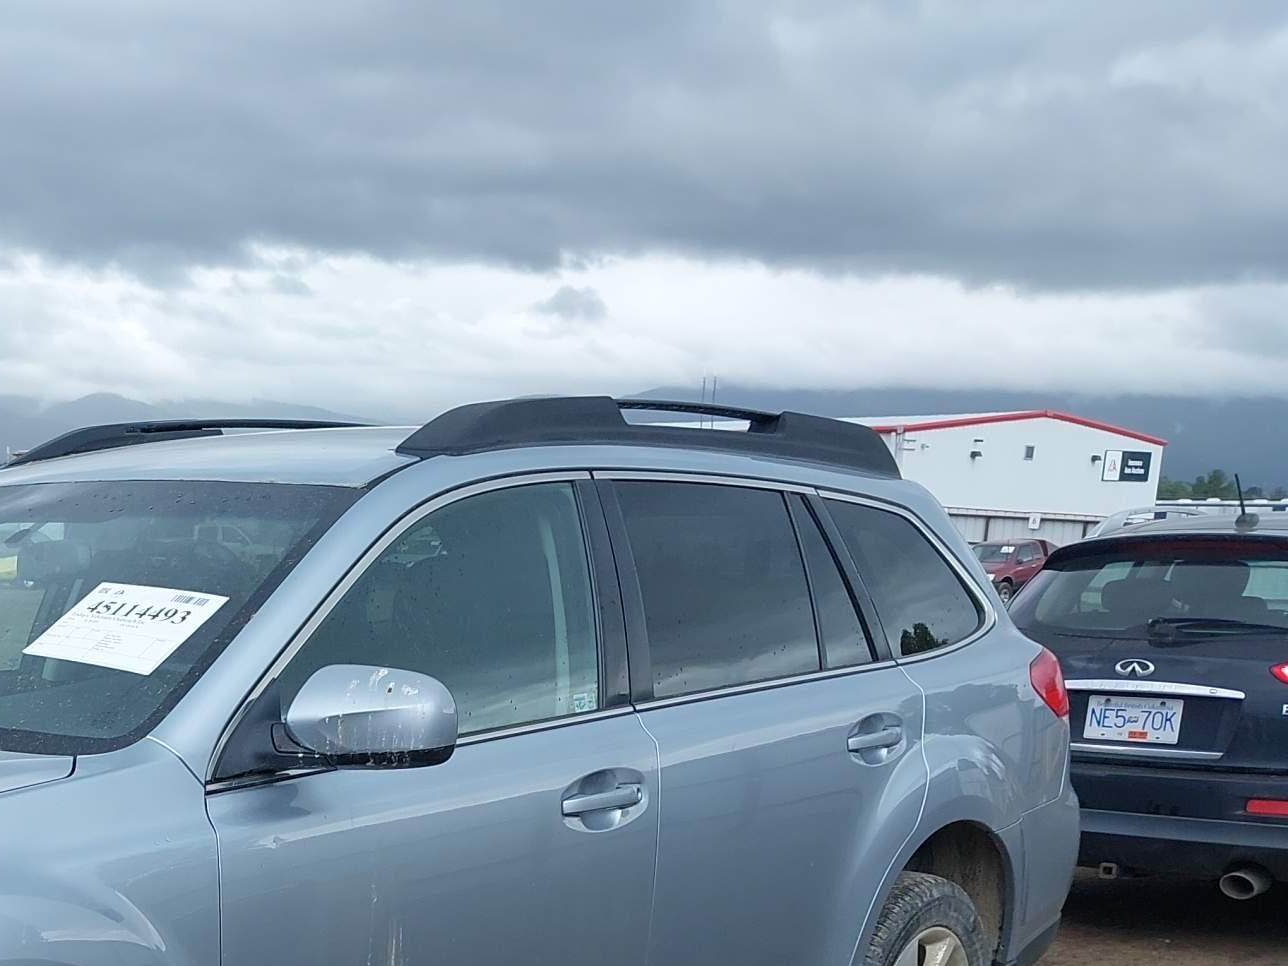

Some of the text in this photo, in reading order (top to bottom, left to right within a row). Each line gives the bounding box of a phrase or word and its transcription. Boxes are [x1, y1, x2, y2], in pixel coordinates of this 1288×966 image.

[87, 600, 192, 625] 45114493
[1089, 707, 1177, 732] NE5 70K
